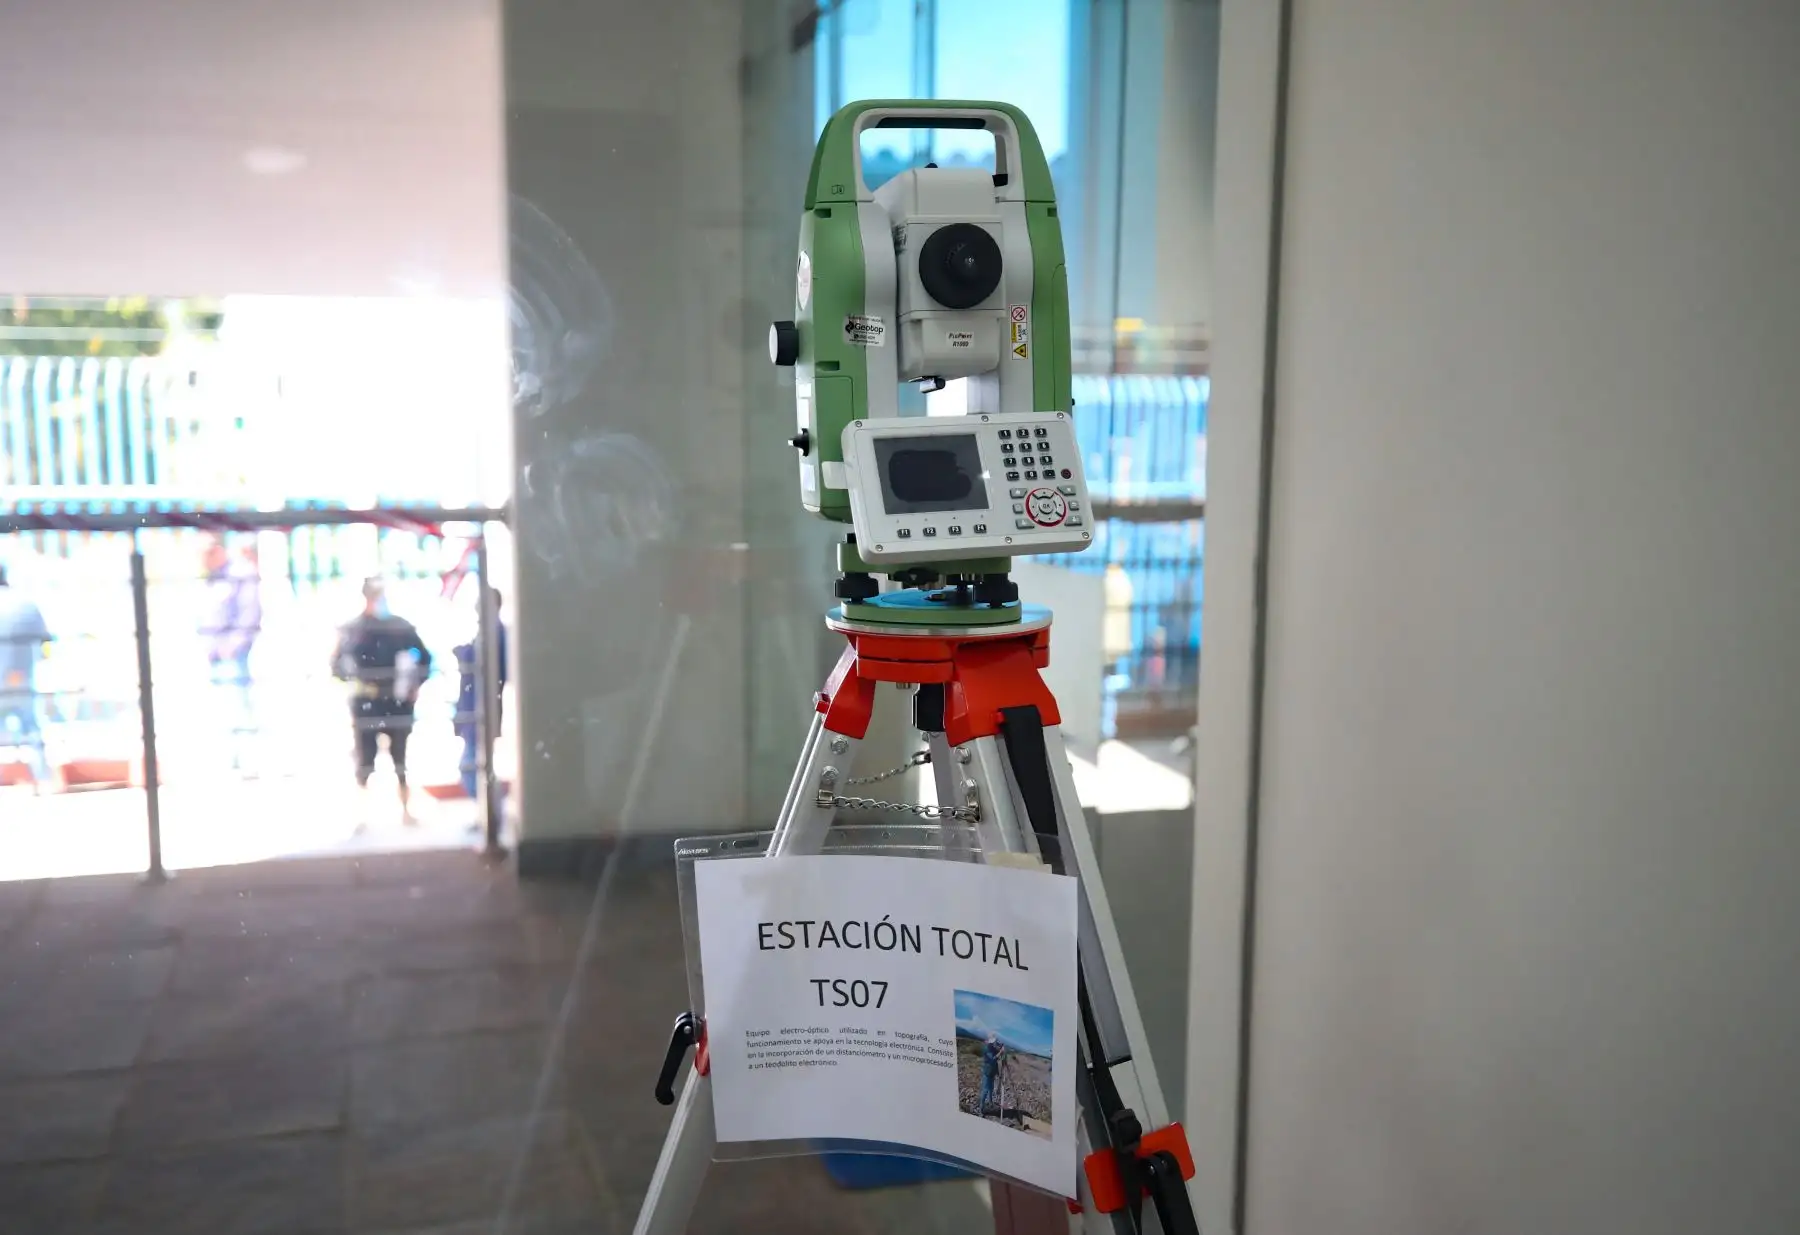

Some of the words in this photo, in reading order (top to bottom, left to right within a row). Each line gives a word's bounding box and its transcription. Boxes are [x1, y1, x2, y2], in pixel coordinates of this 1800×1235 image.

[855, 323, 884, 335] Geotop
[758, 914, 921, 953] ESTACIÓN
[931, 926, 1029, 971] TOTAL
[810, 978, 889, 1009] TS07
[745, 1030, 771, 1038] Equipo
[780, 1026, 829, 1035] electro-óptico
[839, 1026, 868, 1035] utilizado
[938, 1038, 953, 1047] cuyo
[746, 1039, 802, 1048] funcionamiento
[813, 1038, 834, 1046] apoya
[854, 1039, 888, 1049] tecnología
[927, 1046, 953, 1057] Consiste
[765, 1048, 814, 1058] incorporación
[902, 1055, 954, 1068] microprocesador
[765, 1060, 798, 1069] teodolito
